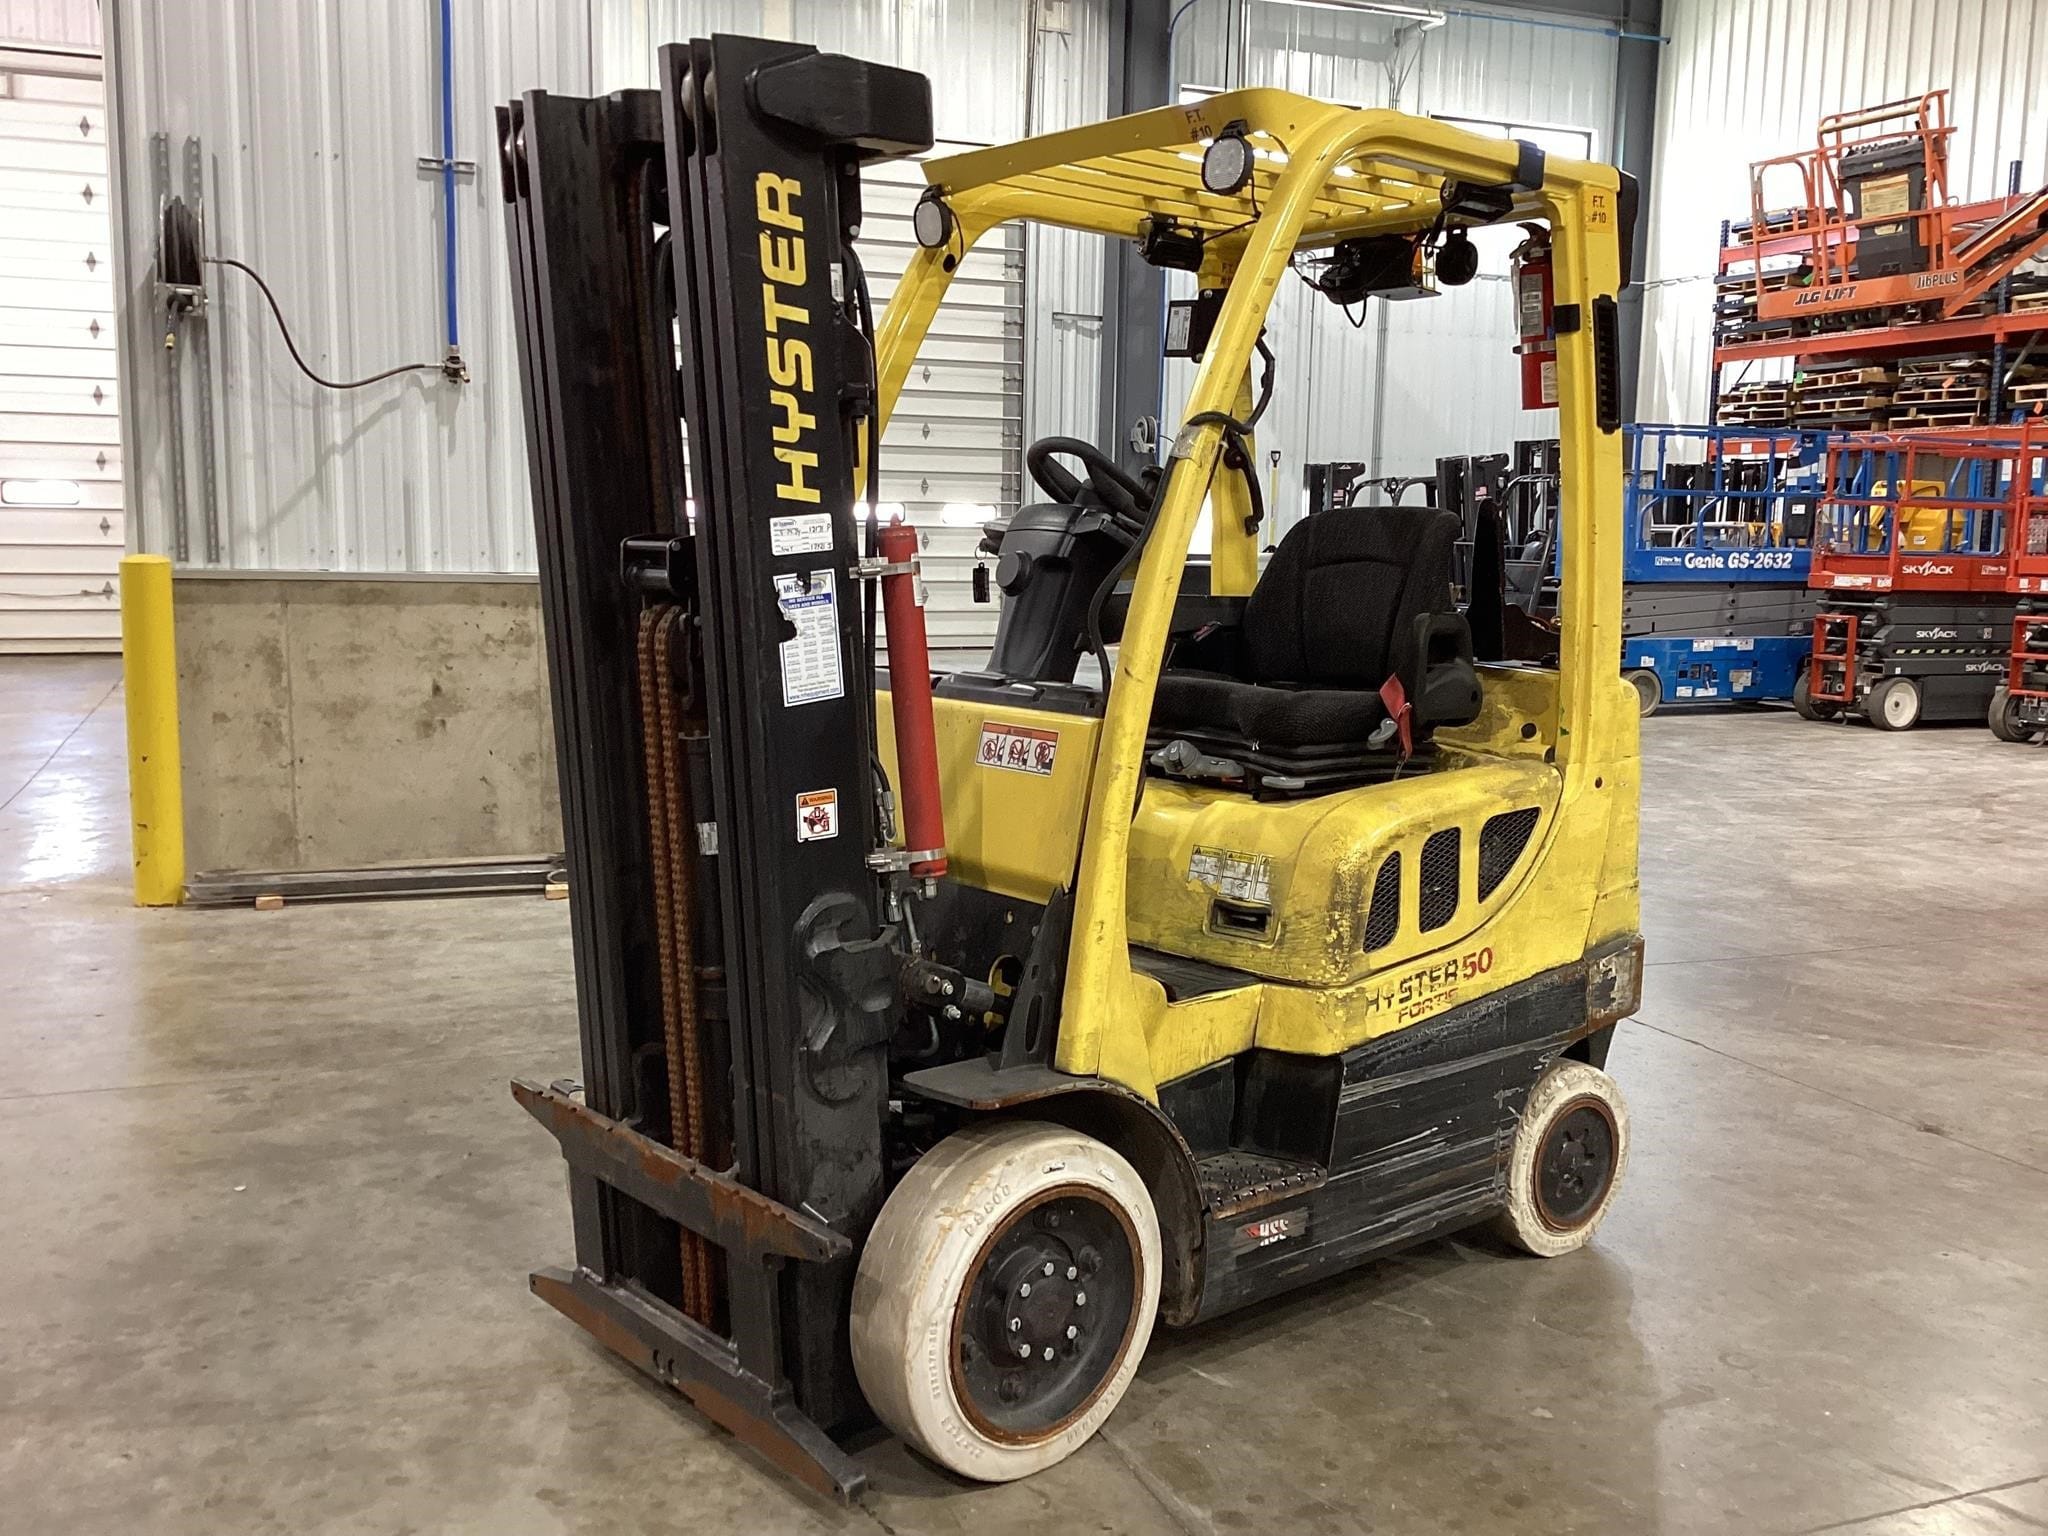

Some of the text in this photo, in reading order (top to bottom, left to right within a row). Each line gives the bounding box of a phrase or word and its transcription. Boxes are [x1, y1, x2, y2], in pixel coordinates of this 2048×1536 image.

[1185, 109, 1205, 124] F.T.
[1191, 125, 1212, 142] #10
[1592, 195, 1605, 208] F.T.
[1591, 211, 1606, 224] #10
[1795, 286, 1857, 305] JLG LIFT
[756, 171, 820, 503] HYSTER
[1684, 552, 1793, 569] Genie GS-2632
[1902, 561, 1954, 576] SKYJACK
[1916, 627, 1958, 639] SKYJACK
[1462, 947, 1494, 980] 50
